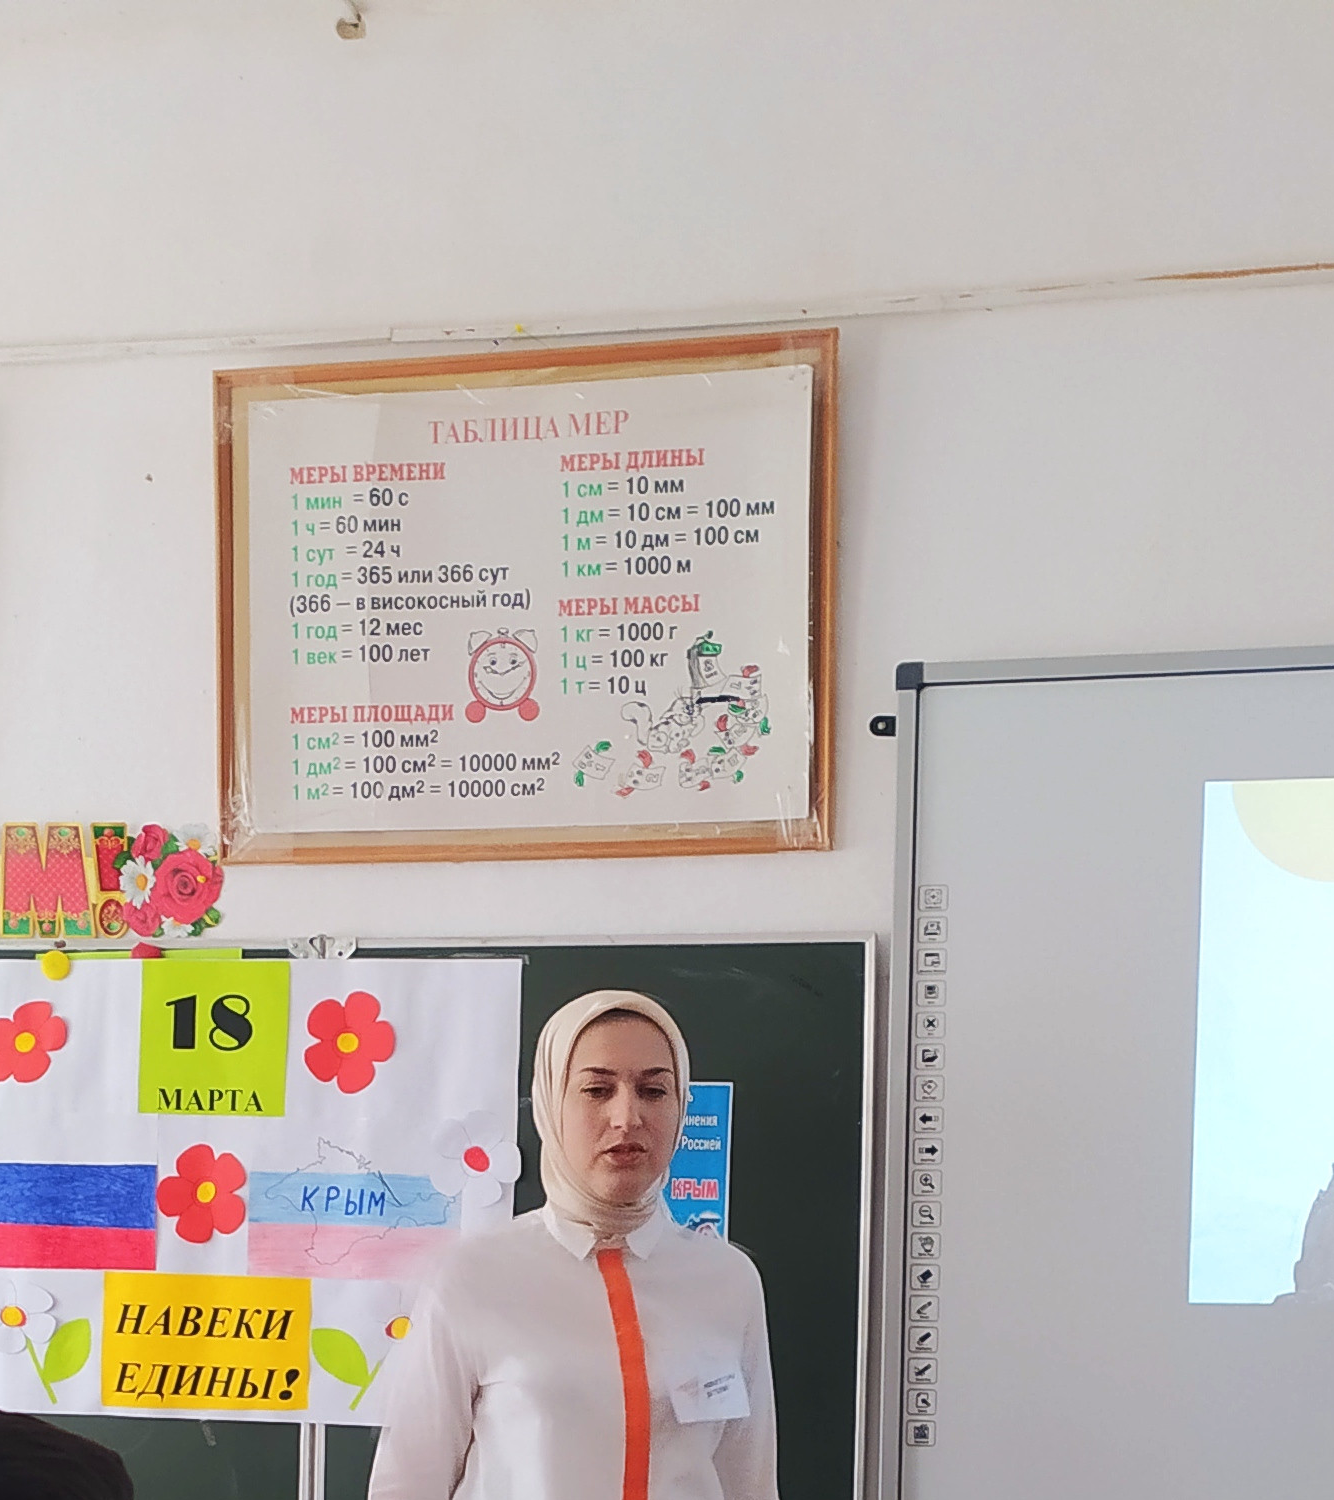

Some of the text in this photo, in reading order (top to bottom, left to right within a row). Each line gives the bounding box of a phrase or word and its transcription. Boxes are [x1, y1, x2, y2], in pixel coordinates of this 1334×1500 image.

[429, 409, 630, 445] ТАБЛИЦА МЕР
[559, 447, 705, 473] МЕРЫ ДЛИНЫ
[289, 461, 446, 485] МЕРЫ ВРЕМЕНИ
[291, 492, 299, 511] 1
[305, 496, 342, 511] мин
[369, 487, 394, 507] 60
[398, 491, 409, 507] с
[562, 480, 570, 499] 1
[577, 483, 603, 498] см
[626, 475, 649, 495] 10
[654, 479, 685, 494] мм
[291, 519, 299, 537] 1
[305, 522, 316, 536] ч
[335, 514, 359, 535] 60
[363, 518, 401, 533] мин
[291, 545, 299, 563] 1
[305, 548, 336, 567] сут
[362, 540, 386, 559] 24
[390, 544, 401, 558] ч
[291, 570, 299, 588] 1
[306, 573, 338, 590] год
[356, 565, 393, 585] 365
[397, 569, 433, 584] или
[437, 563, 474, 584] 366
[478, 566, 510, 586] сут
[561, 560, 569, 578] 1
[576, 563, 602, 577] км
[624, 555, 672, 576] 1000
[676, 559, 691, 574] м
[289, 593, 331, 618] (366
[356, 597, 366, 611] в
[370, 589, 487, 611] високосный
[492, 588, 531, 611] год)
[558, 593, 700, 617] МЕРЫ МАССЫ
[291, 622, 299, 640] 1
[306, 625, 338, 642] год
[359, 617, 381, 637] 12
[385, 621, 423, 637] мес
[291, 647, 301, 666] 1
[306, 650, 338, 665] век
[359, 643, 393, 663] 100
[397, 648, 431, 663] лет
[560, 677, 568, 695] 1
[575, 680, 586, 695] т
[607, 675, 630, 695] 10
[634, 680, 647, 697] ц
[290, 703, 454, 725] МЕРЫ ПЛОЩАДИ
[165, 994, 254, 1052] 18
[157, 1087, 264, 1112] МАРТА
[682, 1135, 721, 1150] Россией
[671, 1179, 718, 1199] КРЫМ
[301, 1186, 386, 1217] КРЫМ
[115, 1303, 294, 1341] НАВЕКИ
[114, 1362, 301, 1402] ЕДИНЫ!
